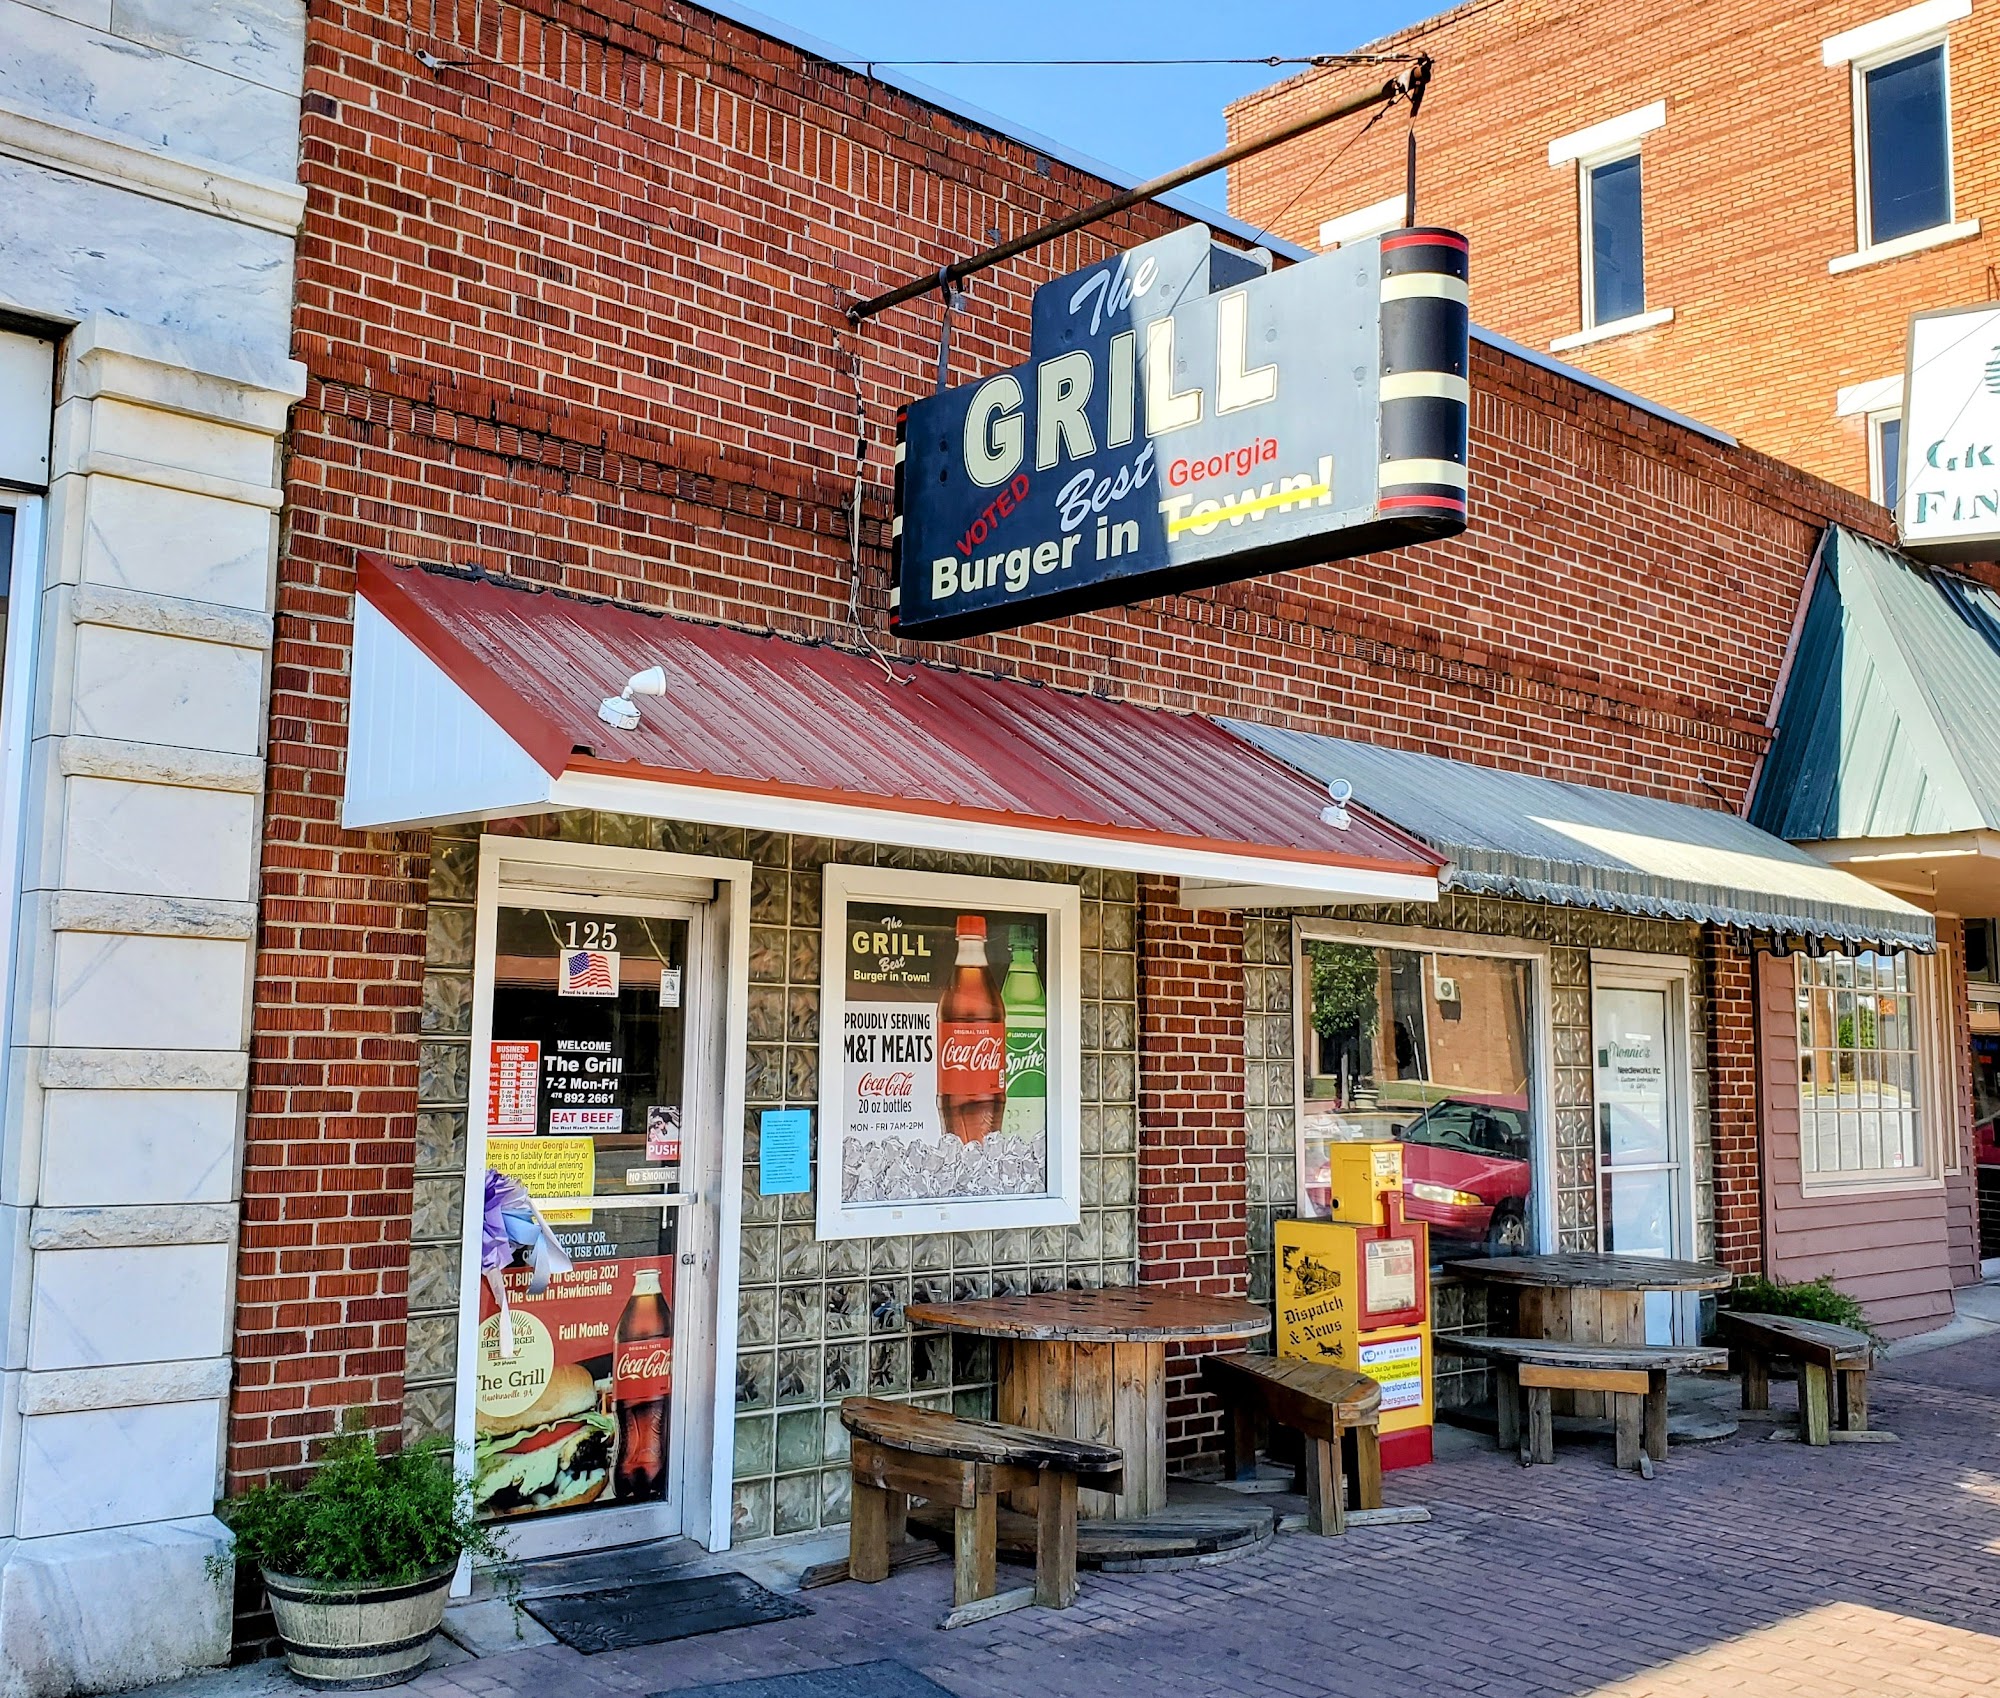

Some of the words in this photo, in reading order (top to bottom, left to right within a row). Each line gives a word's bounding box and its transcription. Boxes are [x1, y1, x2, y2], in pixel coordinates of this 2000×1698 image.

[1069, 251, 1159, 336] The
[963, 290, 1278, 487] GRILL
[1168, 437, 1279, 487] Georgia
[1055, 440, 1155, 532] Best
[955, 473, 1030, 556] VOTED
[931, 533, 1081, 600] Burger
[1095, 516, 1139, 560] in
[1158, 455, 1333, 543] Town!
[881, 916, 903, 931] The
[566, 920, 617, 950] 125
[852, 931, 931, 957] GRILL
[878, 955, 906, 972] Best
[853, 969, 887, 983] Burger
[889, 971, 899, 981] in
[901, 971, 930, 982] Town!
[844, 1012, 888, 1029] PROUDLY
[891, 1013, 930, 1030] SERVING
[557, 1040, 612, 1051] WELCOME
[844, 1034, 876, 1063] M&T
[882, 1035, 932, 1063] MEATS
[942, 1036, 1003, 1071] Coca-Cola
[544, 1056, 579, 1072] The
[584, 1056, 622, 1073] Grill
[1006, 1050, 1044, 1075] Sprite
[546, 1078, 566, 1089] 7-2
[570, 1078, 618, 1090] Mon-Fri
[858, 1072, 915, 1097] Coca-Cola
[564, 1093, 585, 1104] 892
[587, 1093, 614, 1104] 2661
[858, 1100, 868, 1114] 20
[872, 1102, 880, 1113] oz
[883, 1099, 912, 1113] bottles
[552, 1112, 577, 1122] EAT
[581, 1112, 614, 1123] BEEF
[489, 1142, 518, 1151] Warning
[520, 1142, 540, 1150] Under
[542, 1141, 568, 1151] Georgia
[570, 1142, 586, 1150] Law,
[649, 1144, 677, 1155] PUSH
[521, 1152, 542, 1161] liability
[544, 1152, 552, 1160] for
[564, 1152, 580, 1161] injury
[489, 1162, 507, 1170] death
[527, 1162, 556, 1170] individual
[558, 1162, 583, 1170] entering
[560, 1172, 576, 1181] injury
[630, 1172, 640, 1182] NO
[642, 1170, 676, 1181] SMOKING
[588, 1231, 606, 1243] FOR
[574, 1245, 592, 1257] USE
[594, 1244, 618, 1256] ONLY
[564, 1267, 598, 1283] Georgia
[600, 1265, 619, 1279] 2021
[508, 1290, 523, 1303] The
[546, 1287, 554, 1300] in
[557, 1282, 612, 1299] Hawkinsville
[1284, 1296, 1344, 1325] Dispatch
[559, 1323, 577, 1340] Full
[579, 1322, 609, 1338] Monte
[1289, 1330, 1300, 1345] &
[1303, 1321, 1342, 1340] News
[481, 1340, 500, 1348] BEST
[513, 1336, 535, 1345] RGER
[617, 1349, 670, 1380] Coca-Cola
[508, 1368, 545, 1387] Grill
